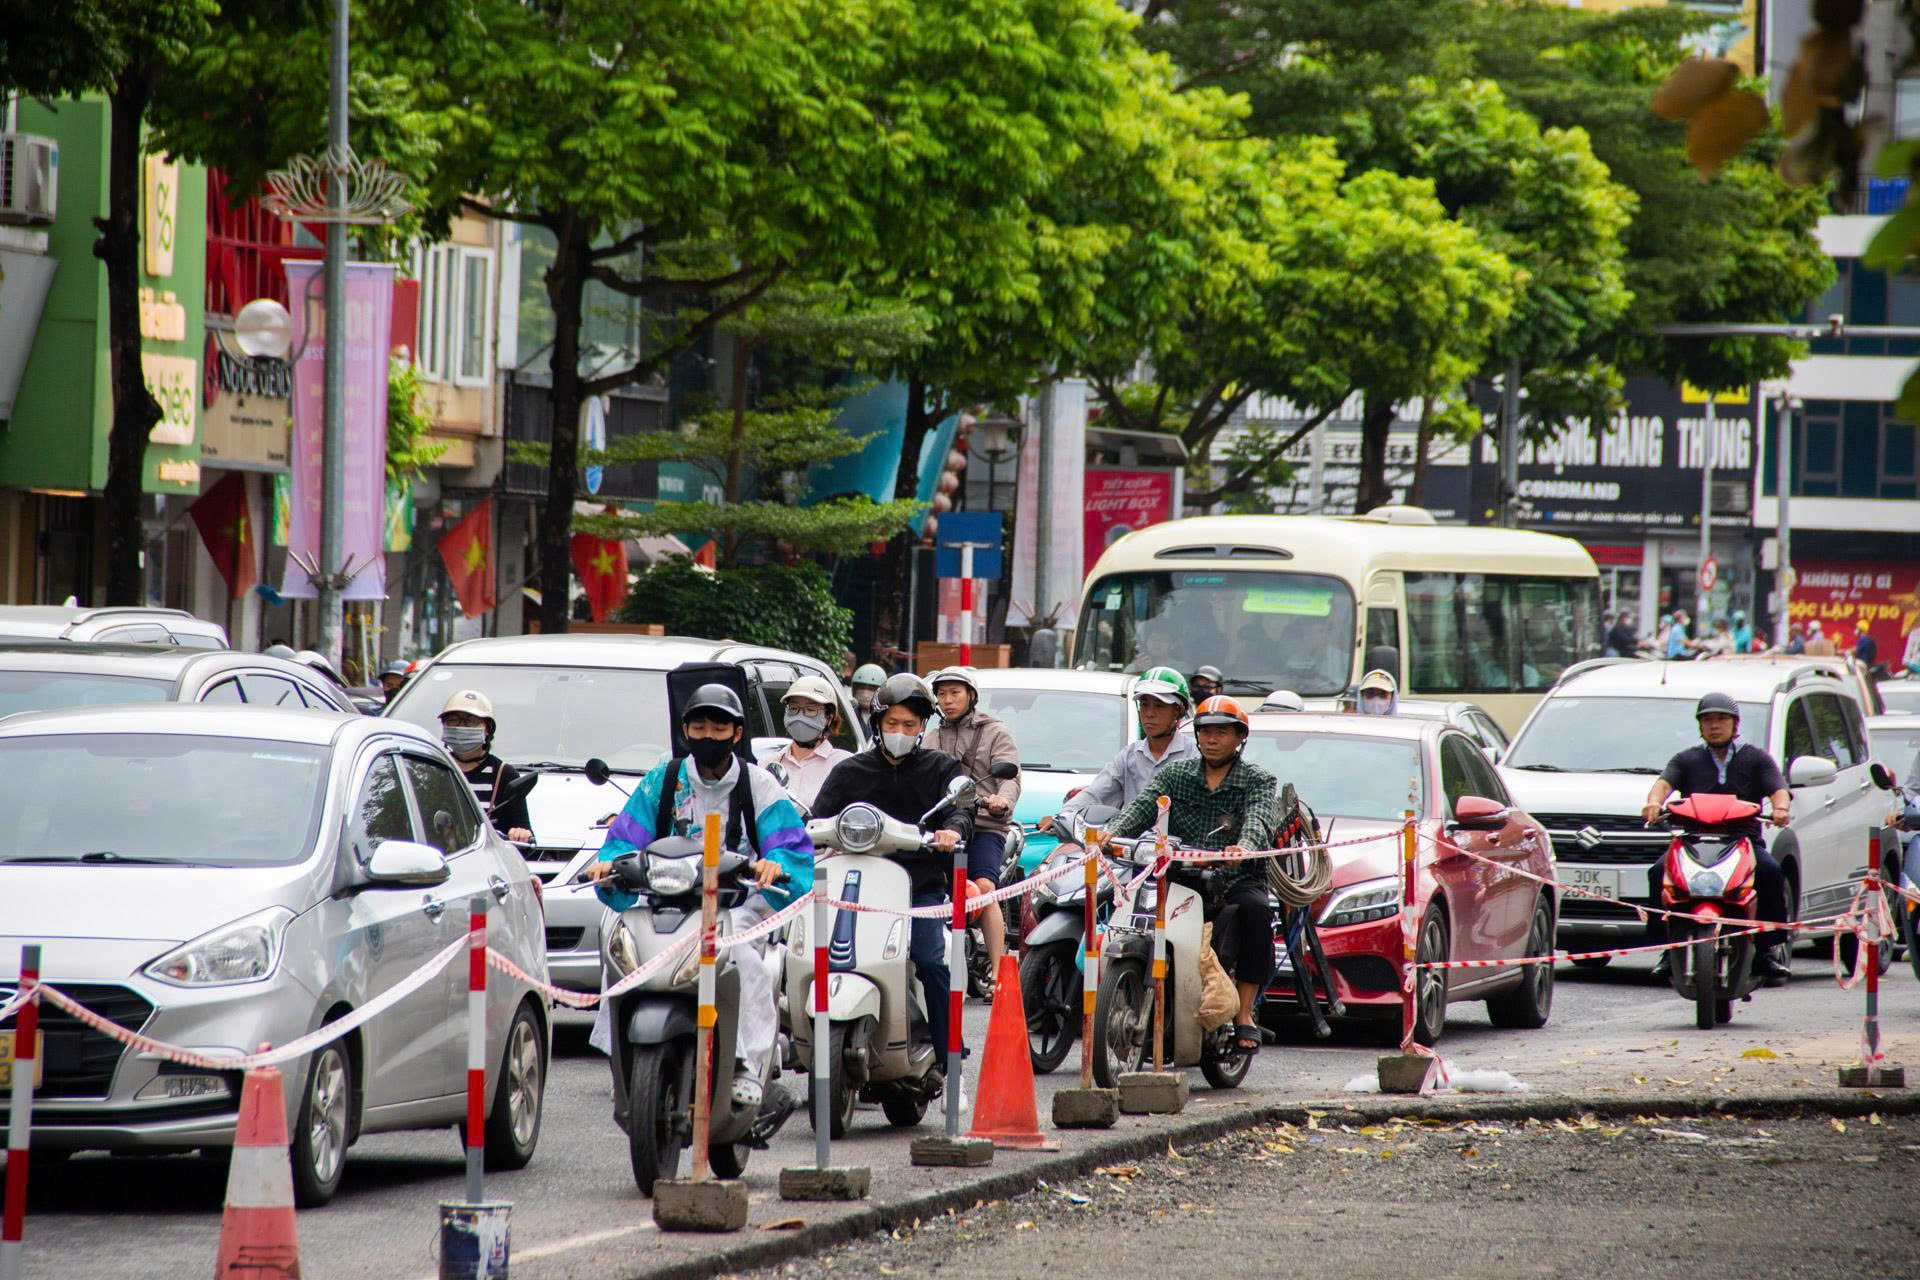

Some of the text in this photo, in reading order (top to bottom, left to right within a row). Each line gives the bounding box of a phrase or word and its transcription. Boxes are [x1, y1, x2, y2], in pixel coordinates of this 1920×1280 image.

[1601, 407, 1664, 467] HÀNG
[1128, 497, 1161, 510] BOX
[1574, 870, 1600, 884] 30K
